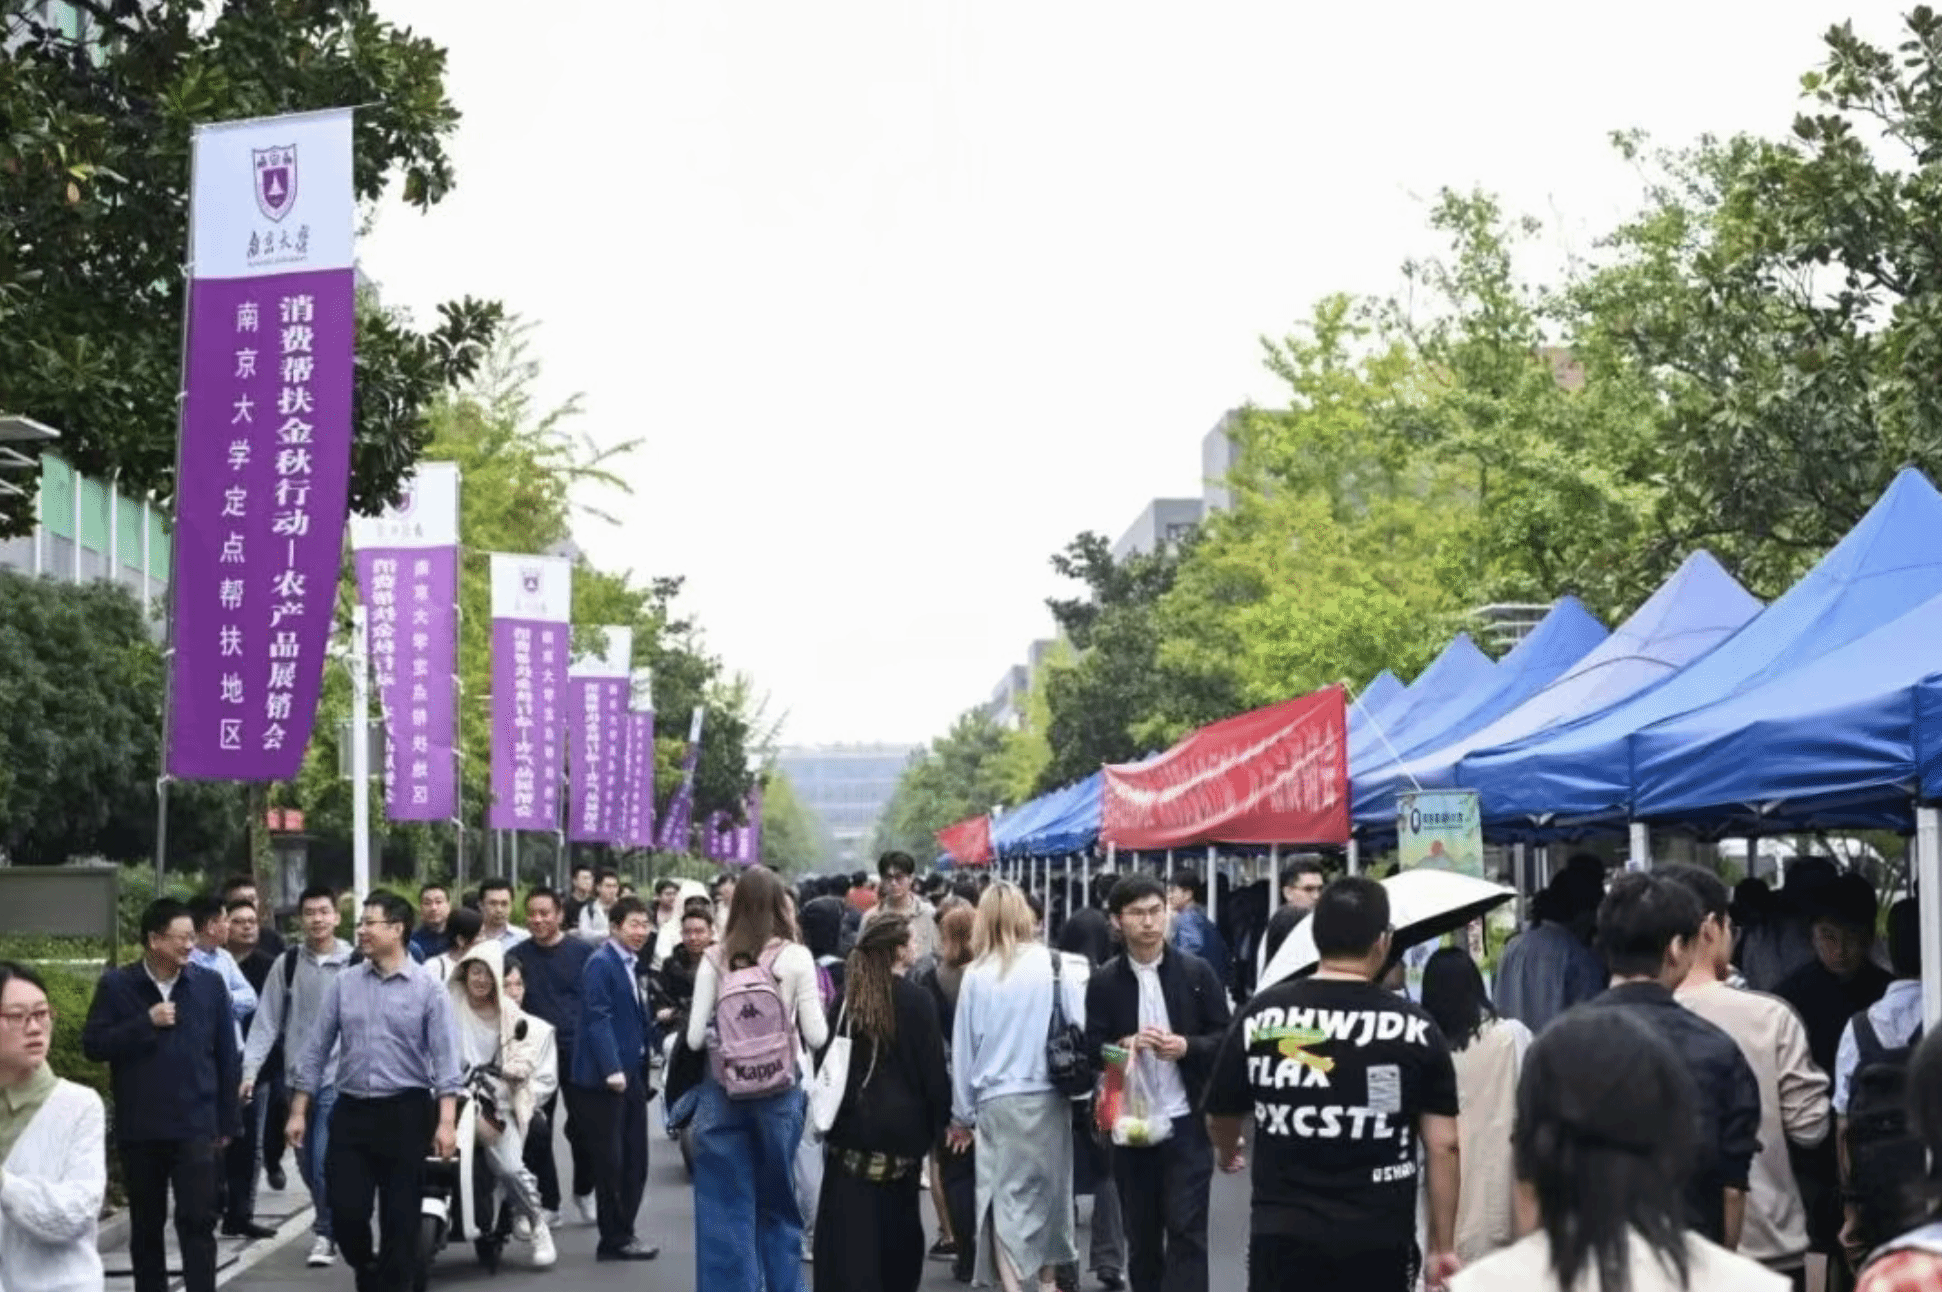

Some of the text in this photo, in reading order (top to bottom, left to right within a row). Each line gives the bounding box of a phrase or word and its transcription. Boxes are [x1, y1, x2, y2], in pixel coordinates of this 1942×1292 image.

[219, 300, 259, 750] 南京大学定点帮扶地区
[734, 1058, 784, 1082] Kappa
